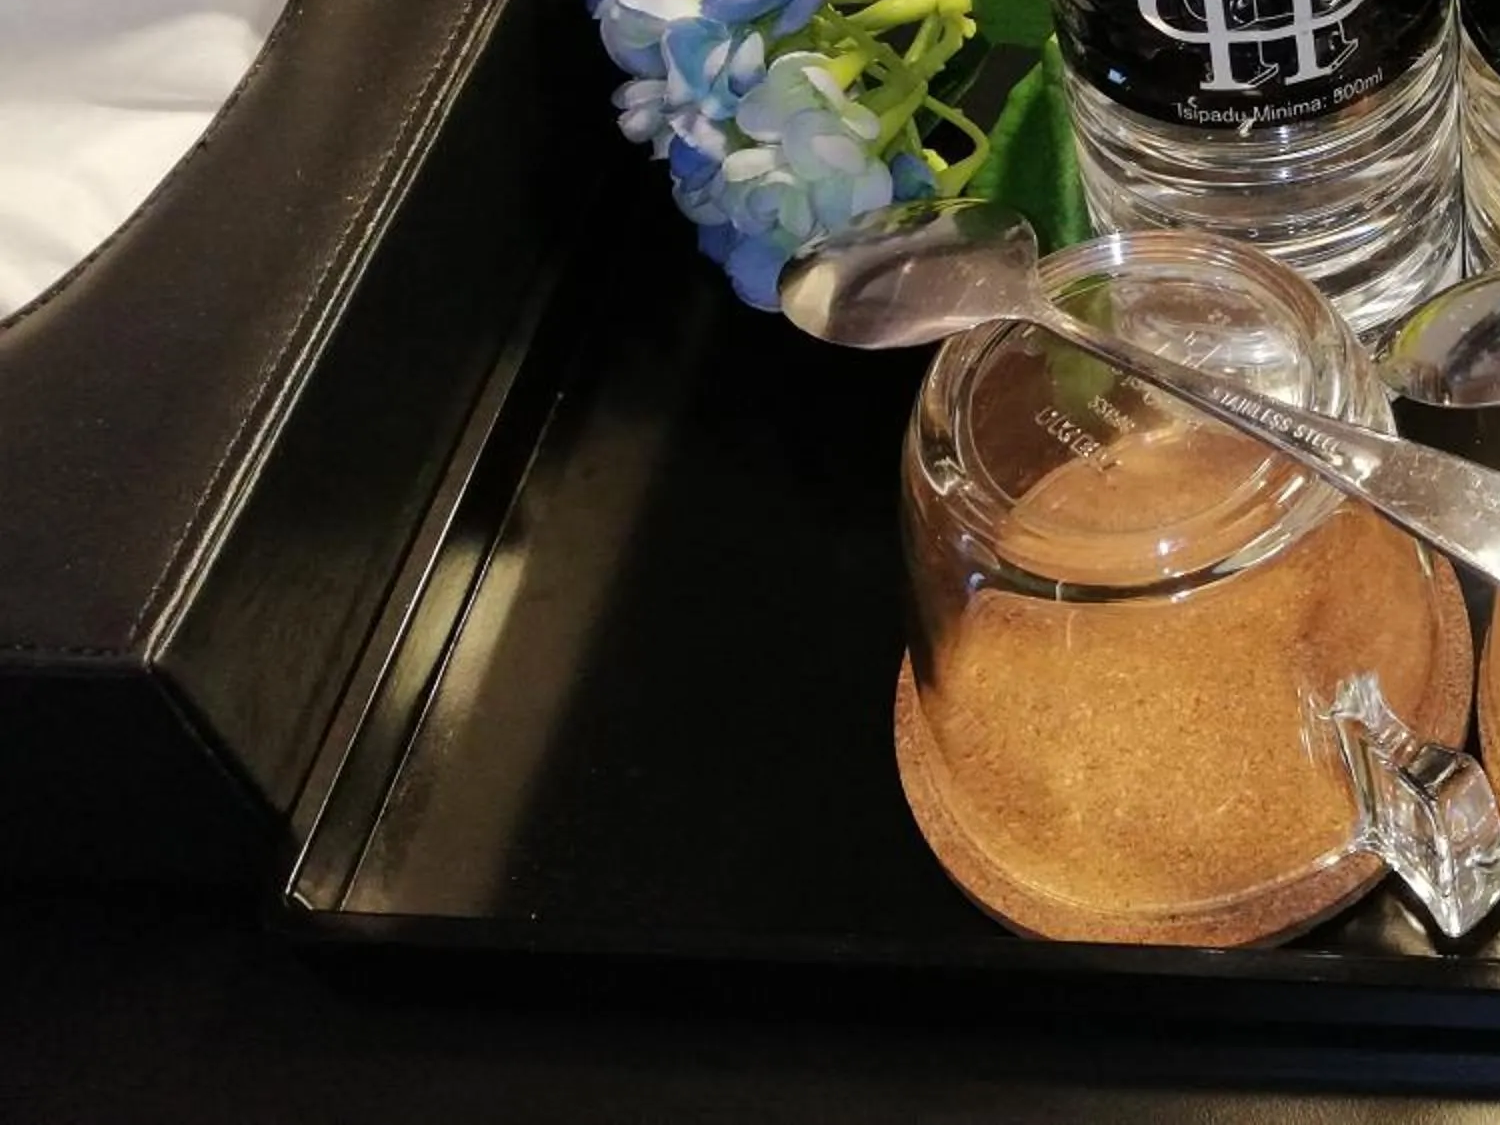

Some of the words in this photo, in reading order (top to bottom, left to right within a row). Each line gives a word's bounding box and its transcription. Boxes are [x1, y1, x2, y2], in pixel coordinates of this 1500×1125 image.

[1177, 101, 1248, 125] Isipadu
[1253, 96, 1328, 123] Minima:
[1210, 386, 1294, 432] STAINLESS
[1293, 424, 1342, 453] STEEL
